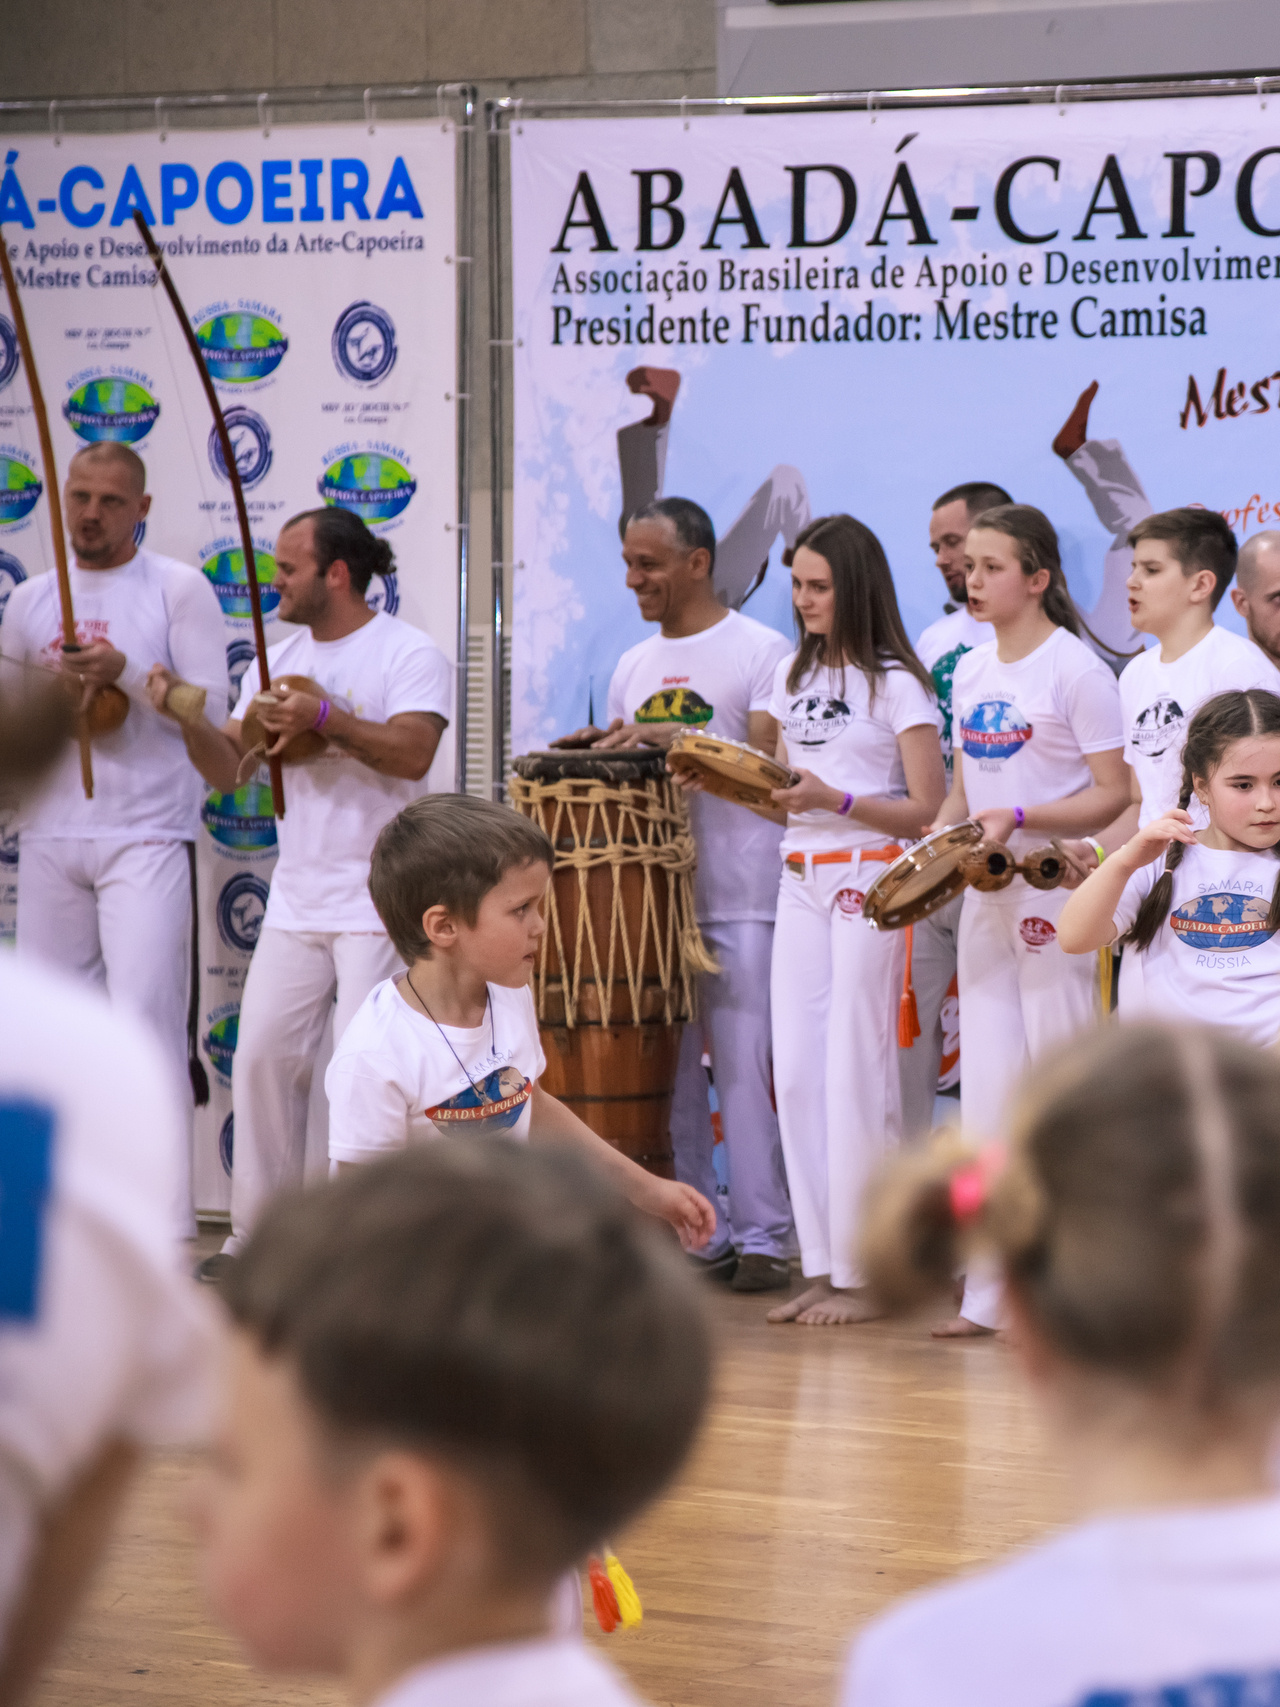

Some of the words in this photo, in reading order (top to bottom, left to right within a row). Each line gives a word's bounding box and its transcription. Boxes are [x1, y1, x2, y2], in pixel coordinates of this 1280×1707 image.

[24, 238, 80, 266] Apoio
[84, 242, 95, 260] e
[266, 232, 288, 254] da
[294, 230, 425, 261] Arte-Capoeira
[16, 265, 81, 289] Mestre
[86, 263, 158, 289] Camisa
[551, 259, 708, 302] Associação
[718, 255, 860, 292] Brasileira
[871, 254, 904, 289] de
[915, 252, 1007, 299] Apoio
[1018, 261, 1033, 286] e
[551, 302, 730, 345] Presidente
[741, 300, 921, 343] Fundador:
[934, 299, 1059, 341] Mestre
[1070, 293, 1208, 338] Camisa
[1197, 879, 1264, 896] SAMARA
[1174, 919, 1267, 934] ABADÁ-CAPOEI
[1195, 952, 1252, 970] RÚSSIA
[458, 1048, 515, 1086] SAMARA
[431, 1090, 530, 1121] ABADÁ-CAPOEIRA
